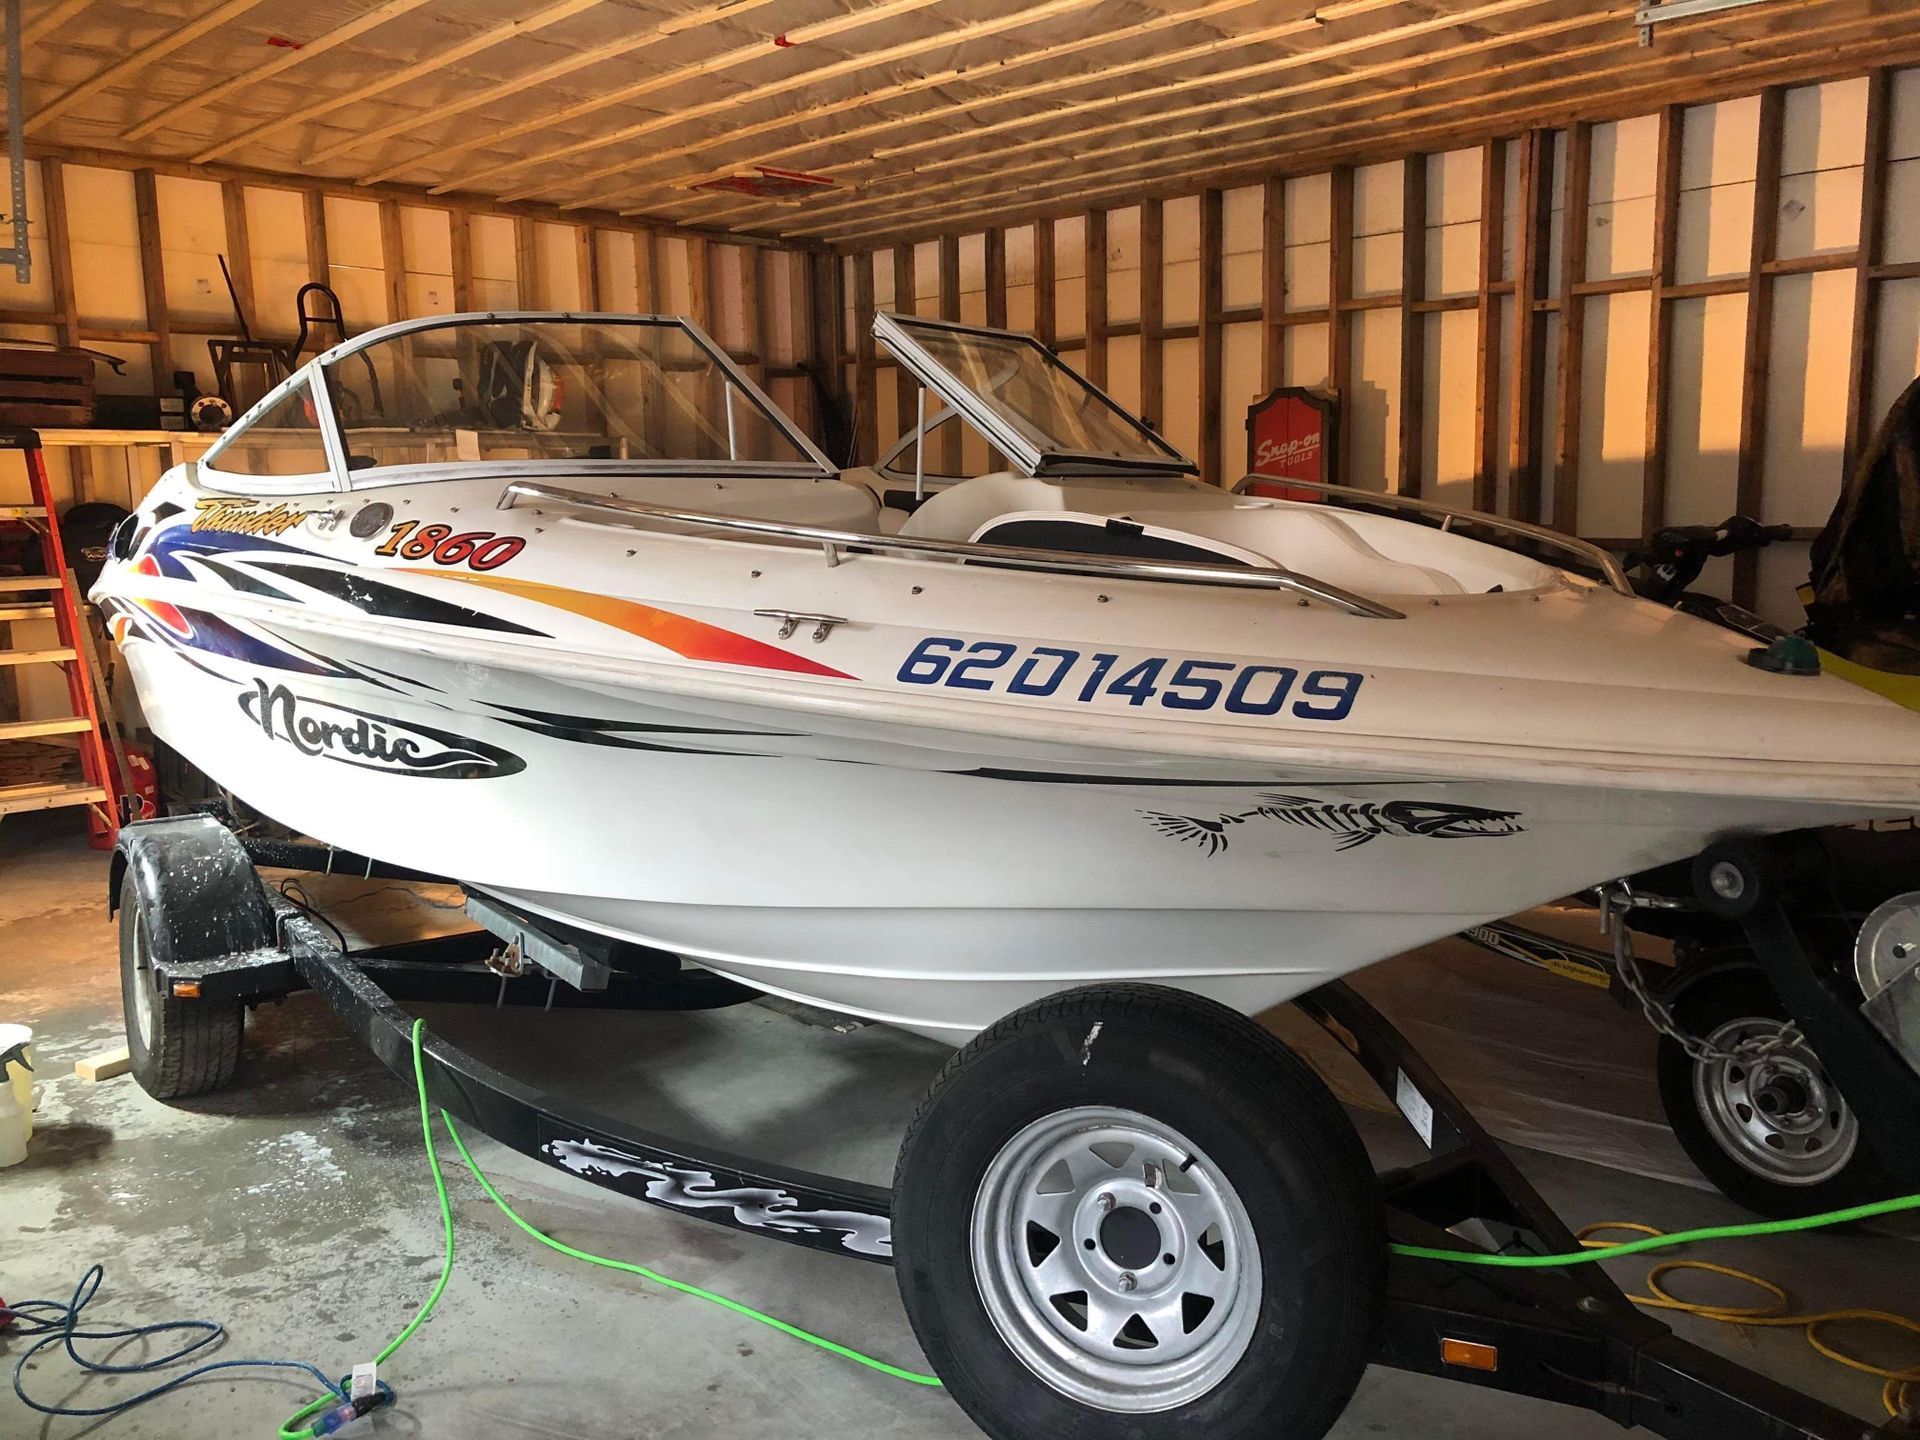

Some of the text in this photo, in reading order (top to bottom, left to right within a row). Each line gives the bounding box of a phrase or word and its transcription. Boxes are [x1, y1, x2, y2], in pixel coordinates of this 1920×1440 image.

[1255, 432, 1320, 467] Snap-on
[1280, 451, 1314, 468] TOOLS
[191, 497, 308, 536] Thunder
[375, 520, 526, 571] 1860
[896, 636, 1365, 721] 62D14509
[252, 677, 499, 769] Nordic
